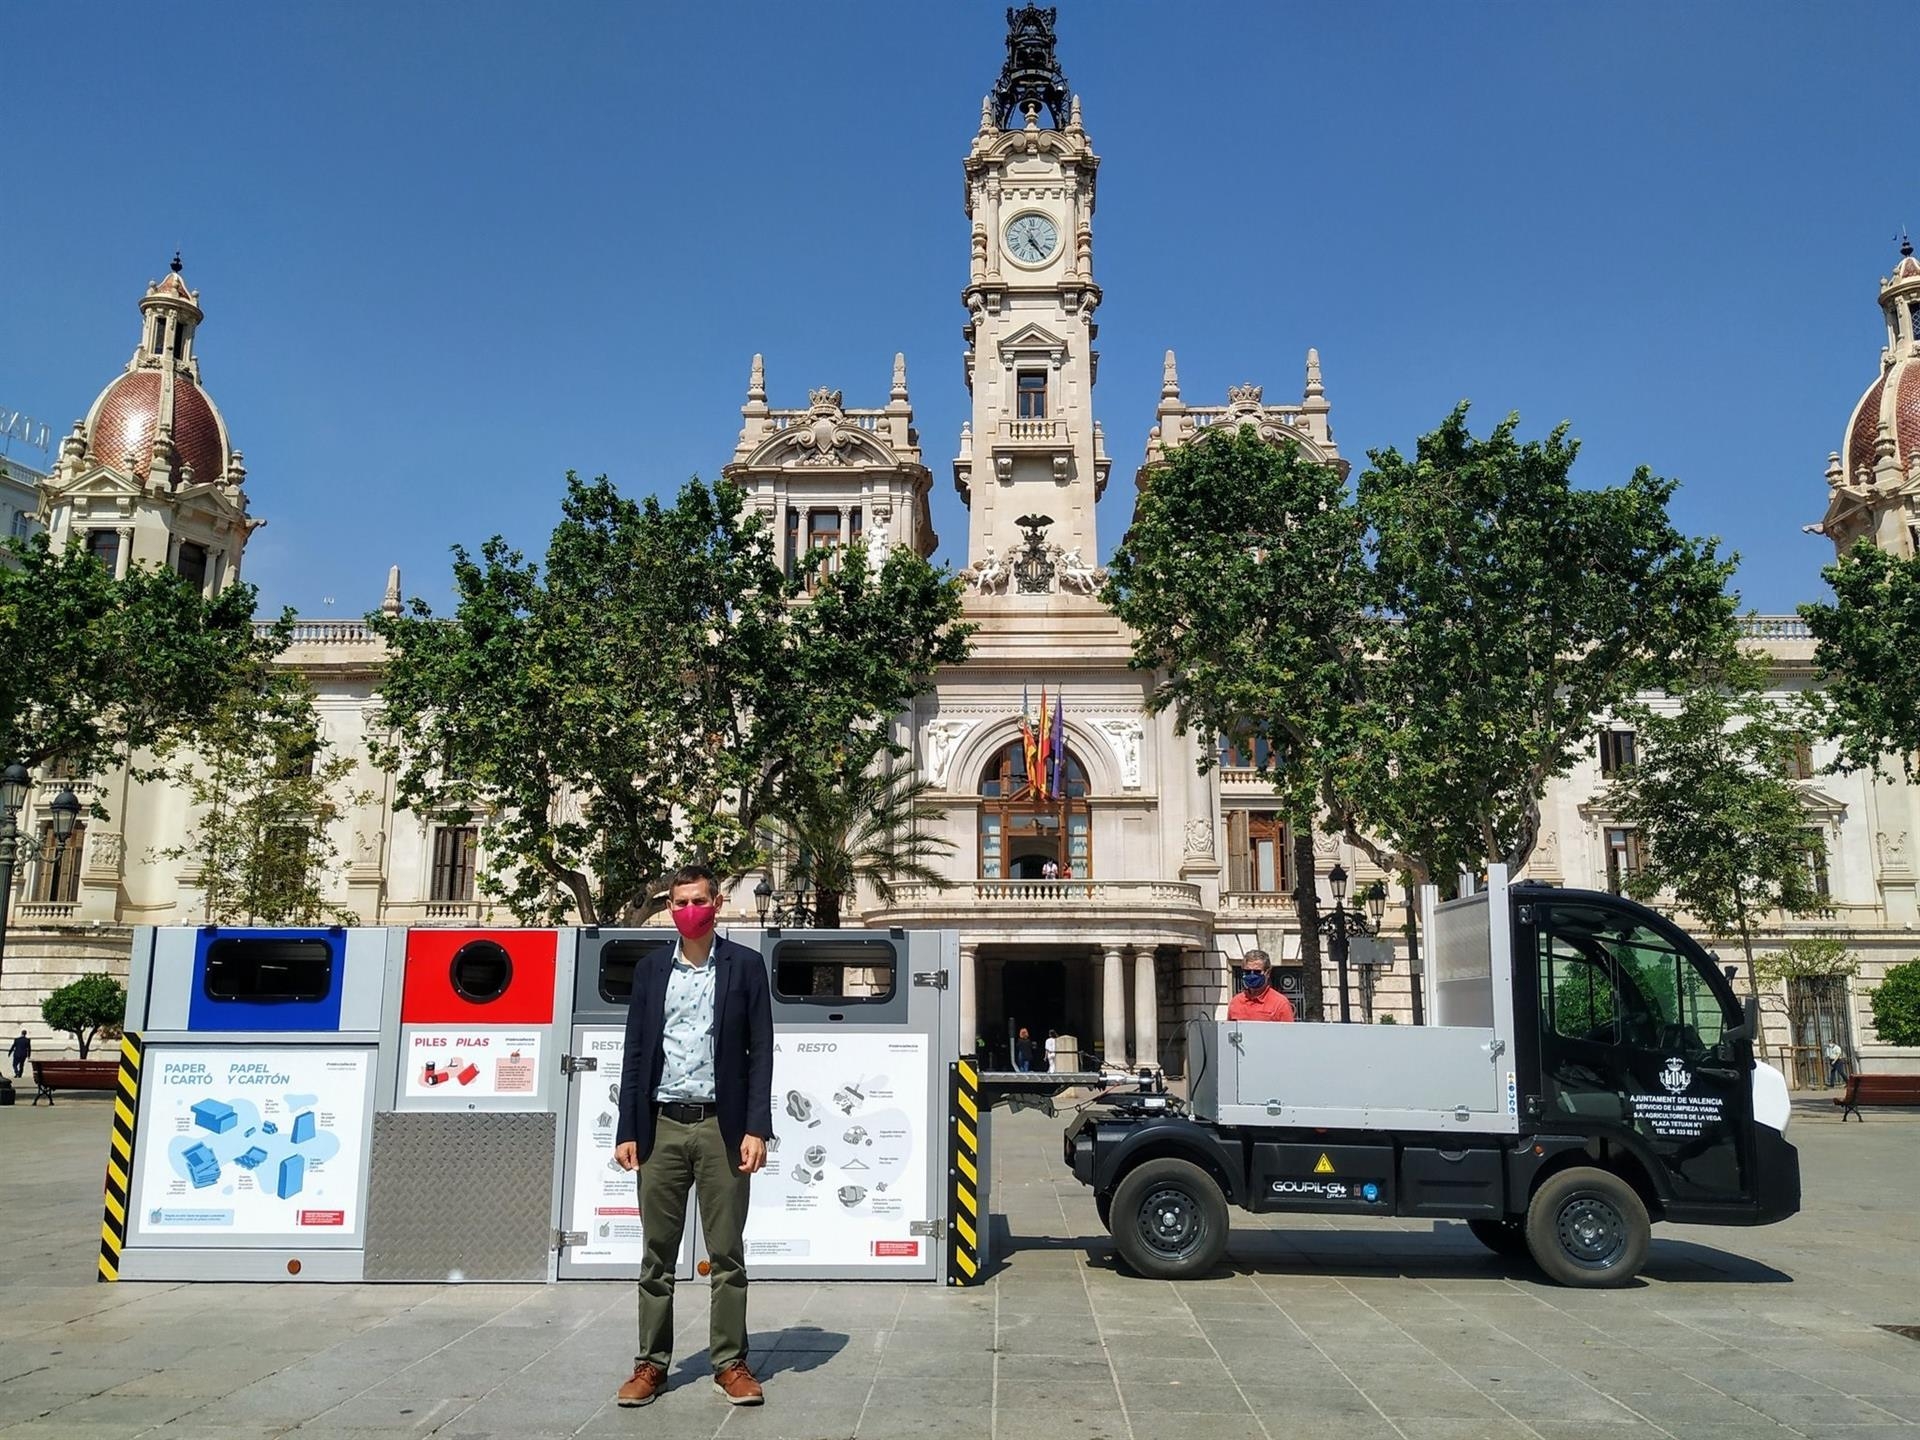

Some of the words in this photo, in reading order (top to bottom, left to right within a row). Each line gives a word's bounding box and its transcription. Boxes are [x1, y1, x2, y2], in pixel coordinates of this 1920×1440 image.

[415, 1038, 447, 1047] PILES
[456, 1038, 490, 1047] PILAS
[592, 1041, 624, 1050] REST
[797, 1043, 837, 1053] RESTO
[165, 1064, 206, 1073] PAPER
[229, 1064, 270, 1073] PAPEL
[163, 1075, 167, 1085] I
[170, 1072, 213, 1085] CARTÓ
[227, 1075, 236, 1085] Y
[238, 1072, 290, 1085] CARTÓN
[1630, 1095, 1676, 1103] AJUNTAMENT
[1688, 1097, 1723, 1106] VALENCIA
[1645, 1112, 1687, 1120] AGRICULTORES
